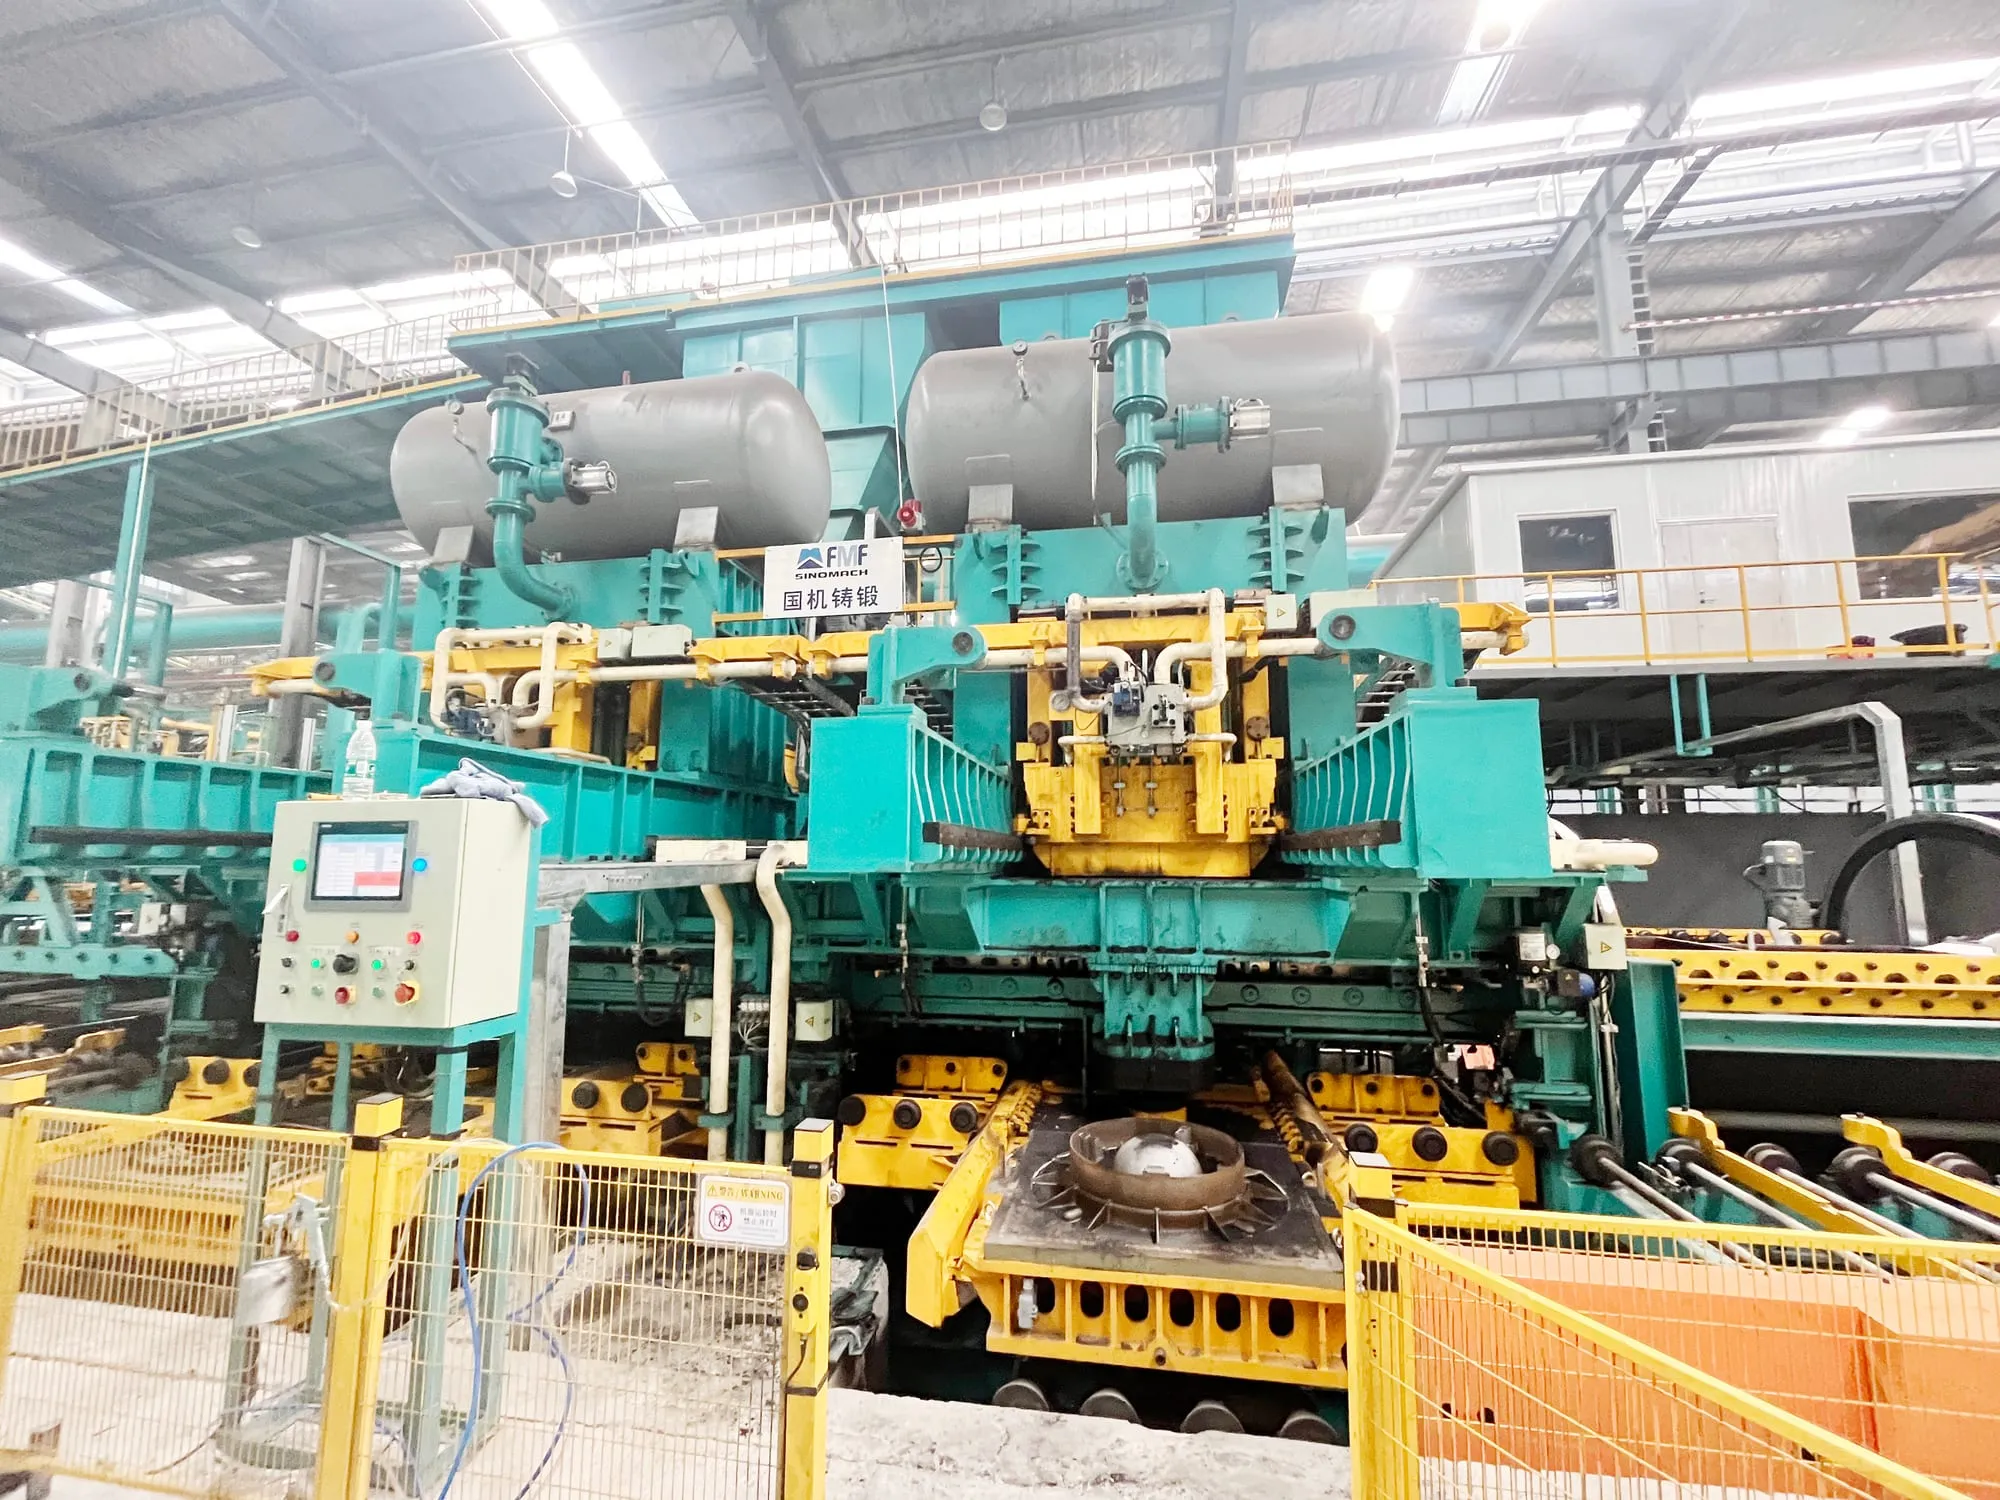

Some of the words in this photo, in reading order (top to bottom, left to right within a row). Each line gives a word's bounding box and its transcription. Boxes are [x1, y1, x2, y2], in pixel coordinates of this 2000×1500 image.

[827, 544, 869, 568] FMF
[795, 569, 868, 580] SINOMACH
[783, 585, 879, 611] 国机铸锻
[741, 1188, 783, 1200] WARNING
